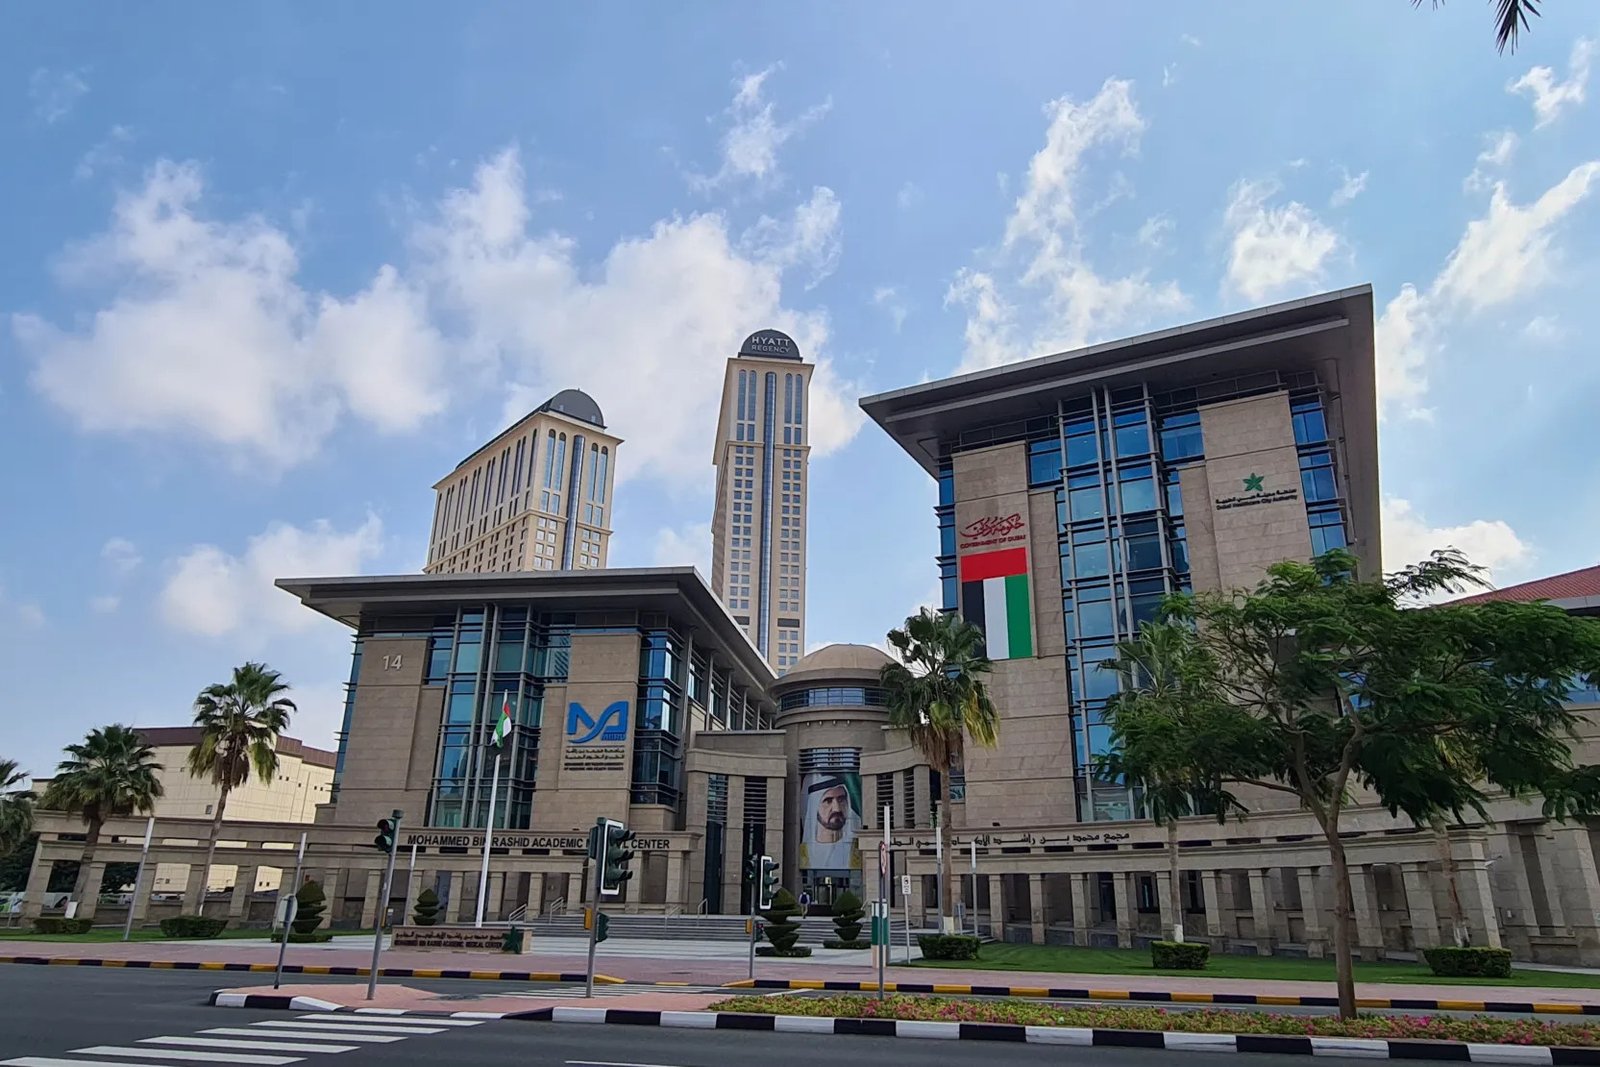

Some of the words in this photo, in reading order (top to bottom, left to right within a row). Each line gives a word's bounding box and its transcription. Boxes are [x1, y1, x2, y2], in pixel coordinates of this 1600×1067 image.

[751, 336, 790, 346] HYATT
[751, 344, 791, 353] REGENCY
[1272, 495, 1298, 503] Authority
[1007, 534, 1027, 542] DUBAI
[383, 654, 402, 671] 14
[407, 835, 470, 846] MOHAMMED
[491, 837, 530, 847] RASHID
[531, 837, 584, 848] ACADEMIC
[631, 839, 670, 849] CENTER
[916, 834, 990, 848] الأكادمي
[1072, 833, 1100, 842] محمد
[1103, 832, 1130, 843] مجمع
